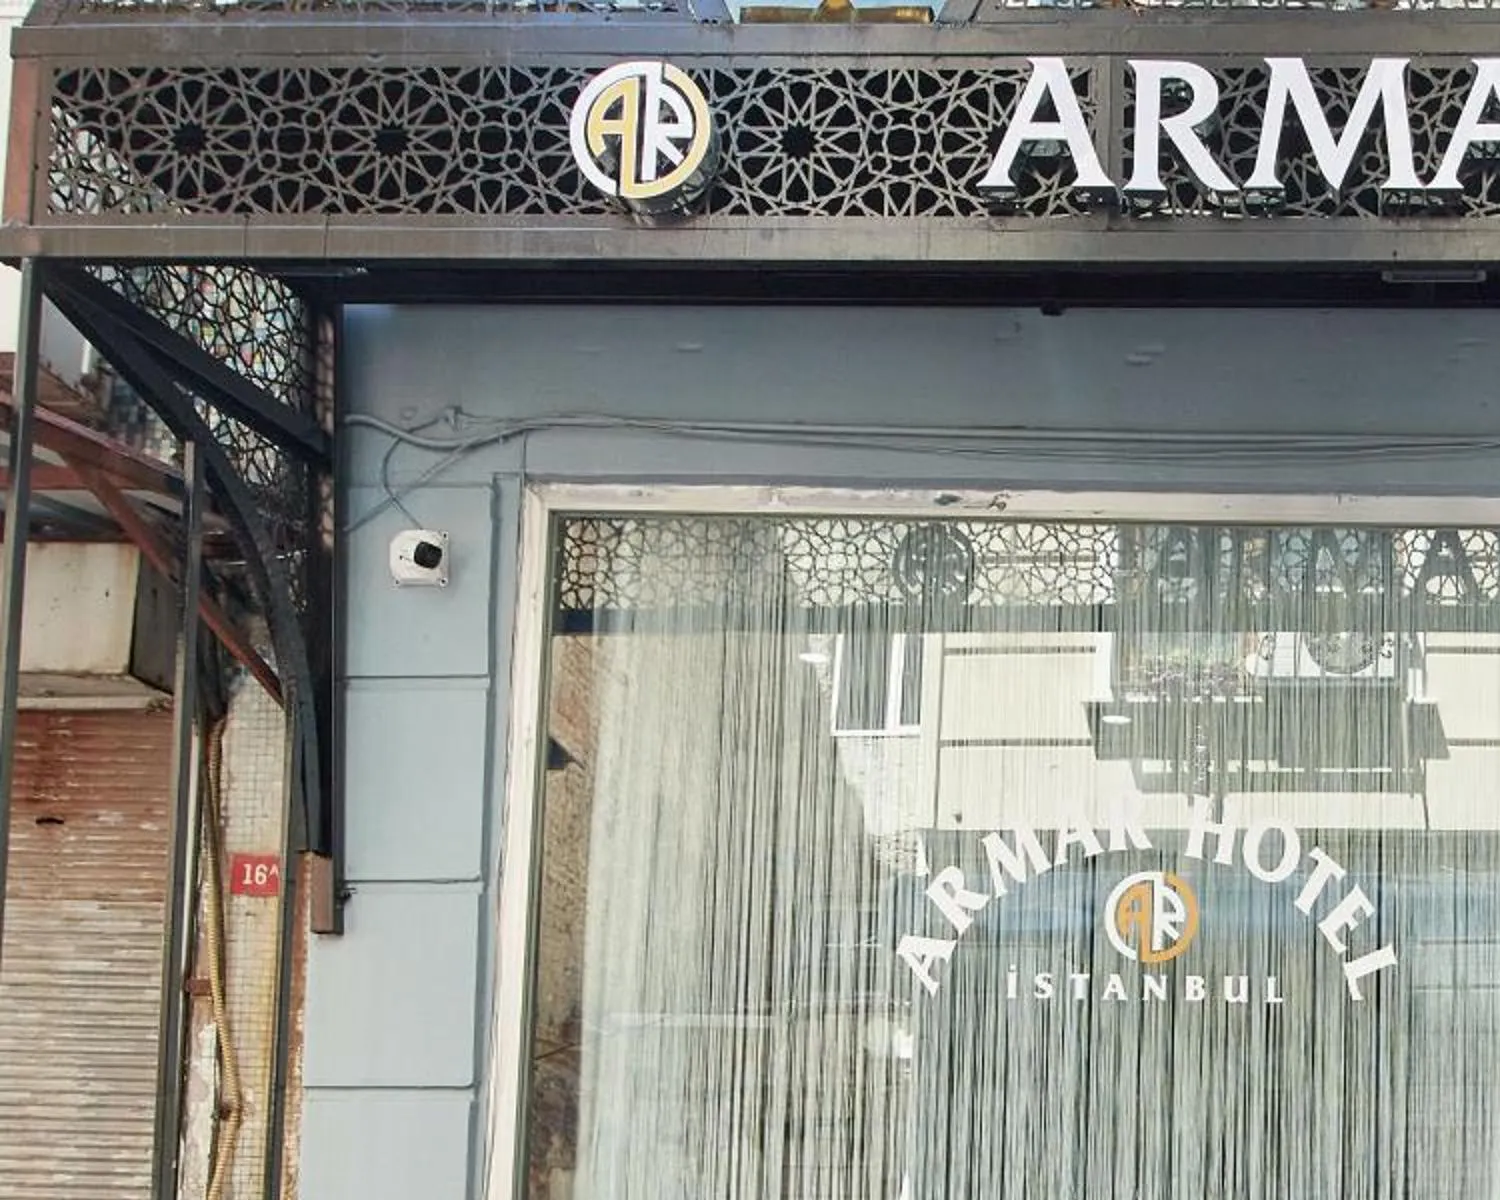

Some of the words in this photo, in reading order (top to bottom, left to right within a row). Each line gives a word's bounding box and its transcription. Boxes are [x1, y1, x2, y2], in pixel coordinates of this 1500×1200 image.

[896, 793, 1153, 996] ARMAR
[1184, 794, 1397, 1000] HOTEL
[1007, 964, 1283, 1003] İSTANBUL
